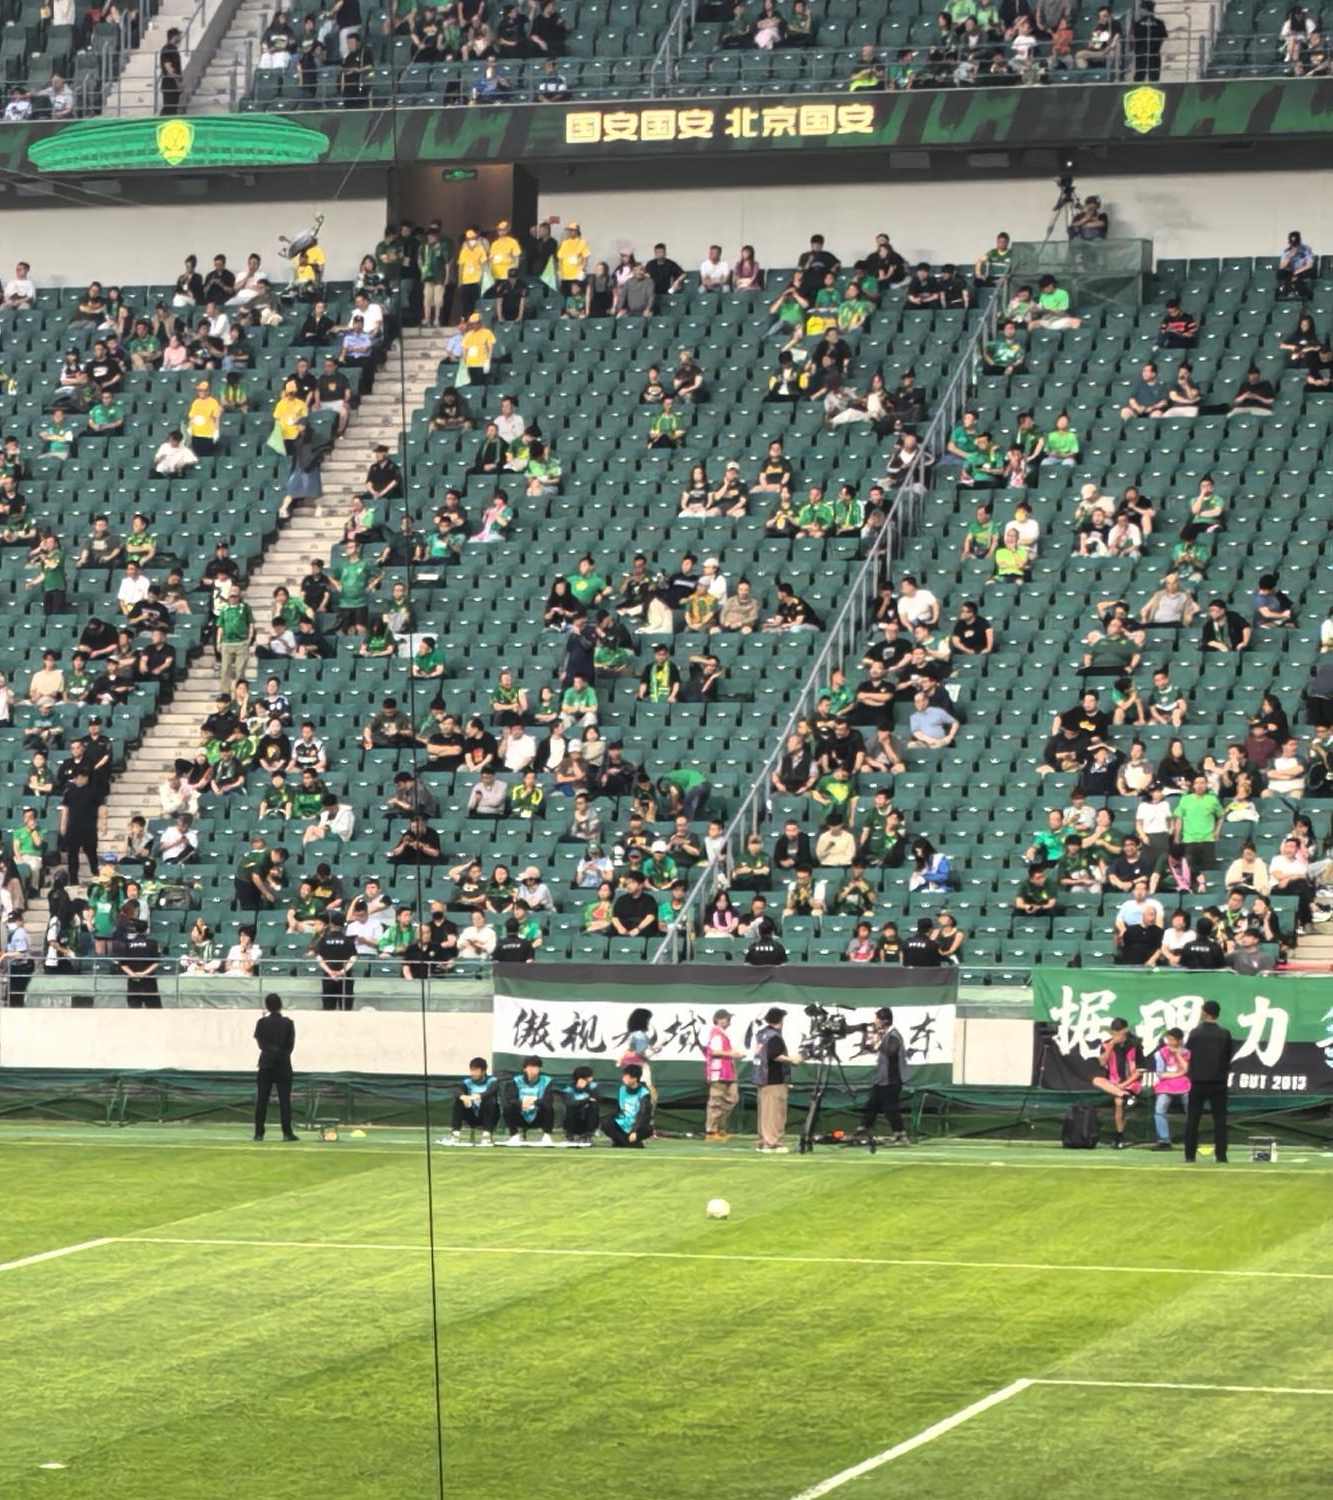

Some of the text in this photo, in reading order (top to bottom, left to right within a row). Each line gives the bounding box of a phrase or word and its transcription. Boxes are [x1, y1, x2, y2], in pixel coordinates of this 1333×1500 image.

[566, 103, 875, 144] 国安国安 北京国安
[1272, 1075, 1307, 1091] 2013
